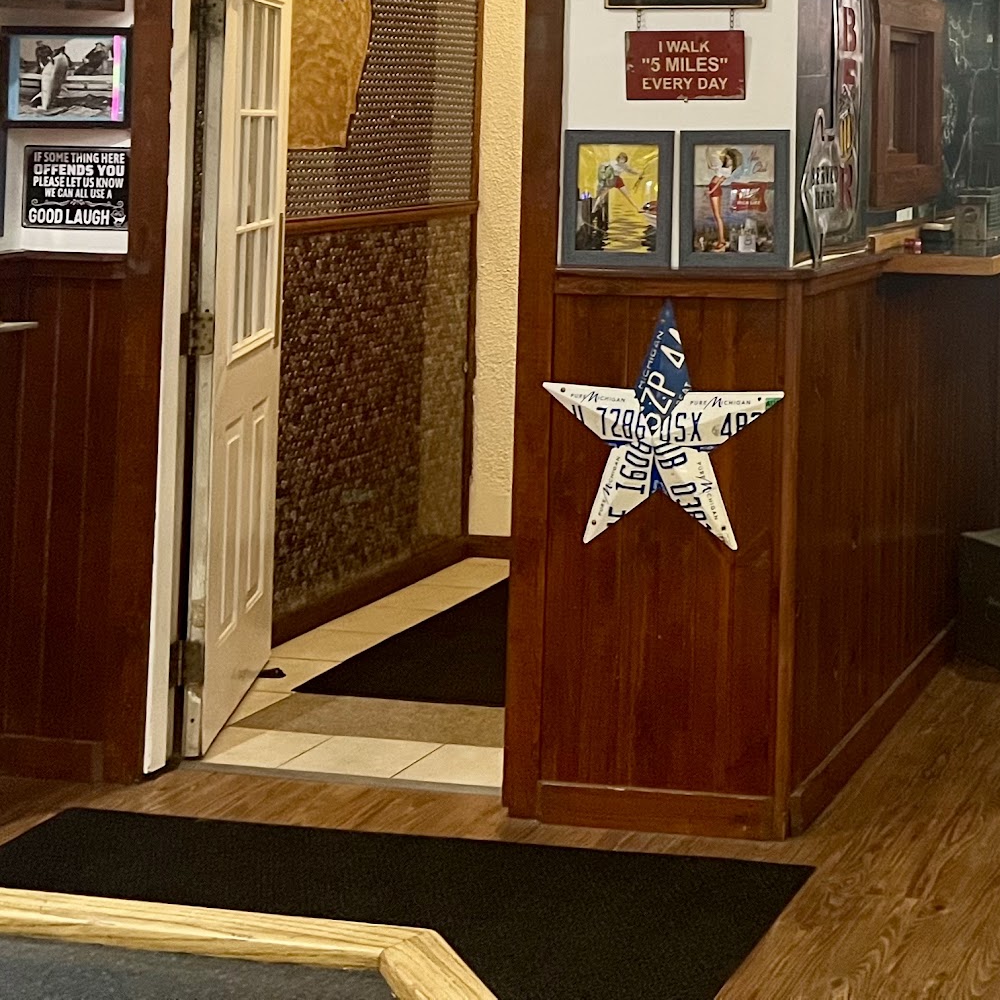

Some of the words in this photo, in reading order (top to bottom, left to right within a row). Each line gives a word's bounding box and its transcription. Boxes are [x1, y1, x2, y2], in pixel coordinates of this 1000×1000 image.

[658, 41, 662, 53] I
[666, 41, 710, 53] WALK
[641, 57, 660, 72] "5
[665, 57, 729, 72] MILES"
[642, 77, 693, 90] EVERY
[697, 77, 728, 90] DAY
[33, 151, 43, 162] IF
[101, 153, 125, 164] HERE
[33, 164, 94, 176] OFFENDS
[97, 165, 125, 176] YOU
[33, 176, 65, 187] PLEASE
[66, 176, 82, 187] LET
[83, 177, 95, 188] US
[96, 177, 124, 188] KNOW
[45, 188, 56, 197] WE
[57, 188, 74, 198] CAN
[75, 188, 89, 198] ALL
[90, 189, 105, 199] USE
[106, 189, 113, 199] A
[28, 208, 63, 224] GOOD
[65, 208, 110, 226] LAUGH
[637, 331, 665, 390] MICHIGAN
[581, 391, 626, 404] MICHIGAN
[704, 396, 751, 410] MICHIGAN
[602, 456, 621, 504] MICHIGAN
[699, 473, 719, 520] MICHIGAN
